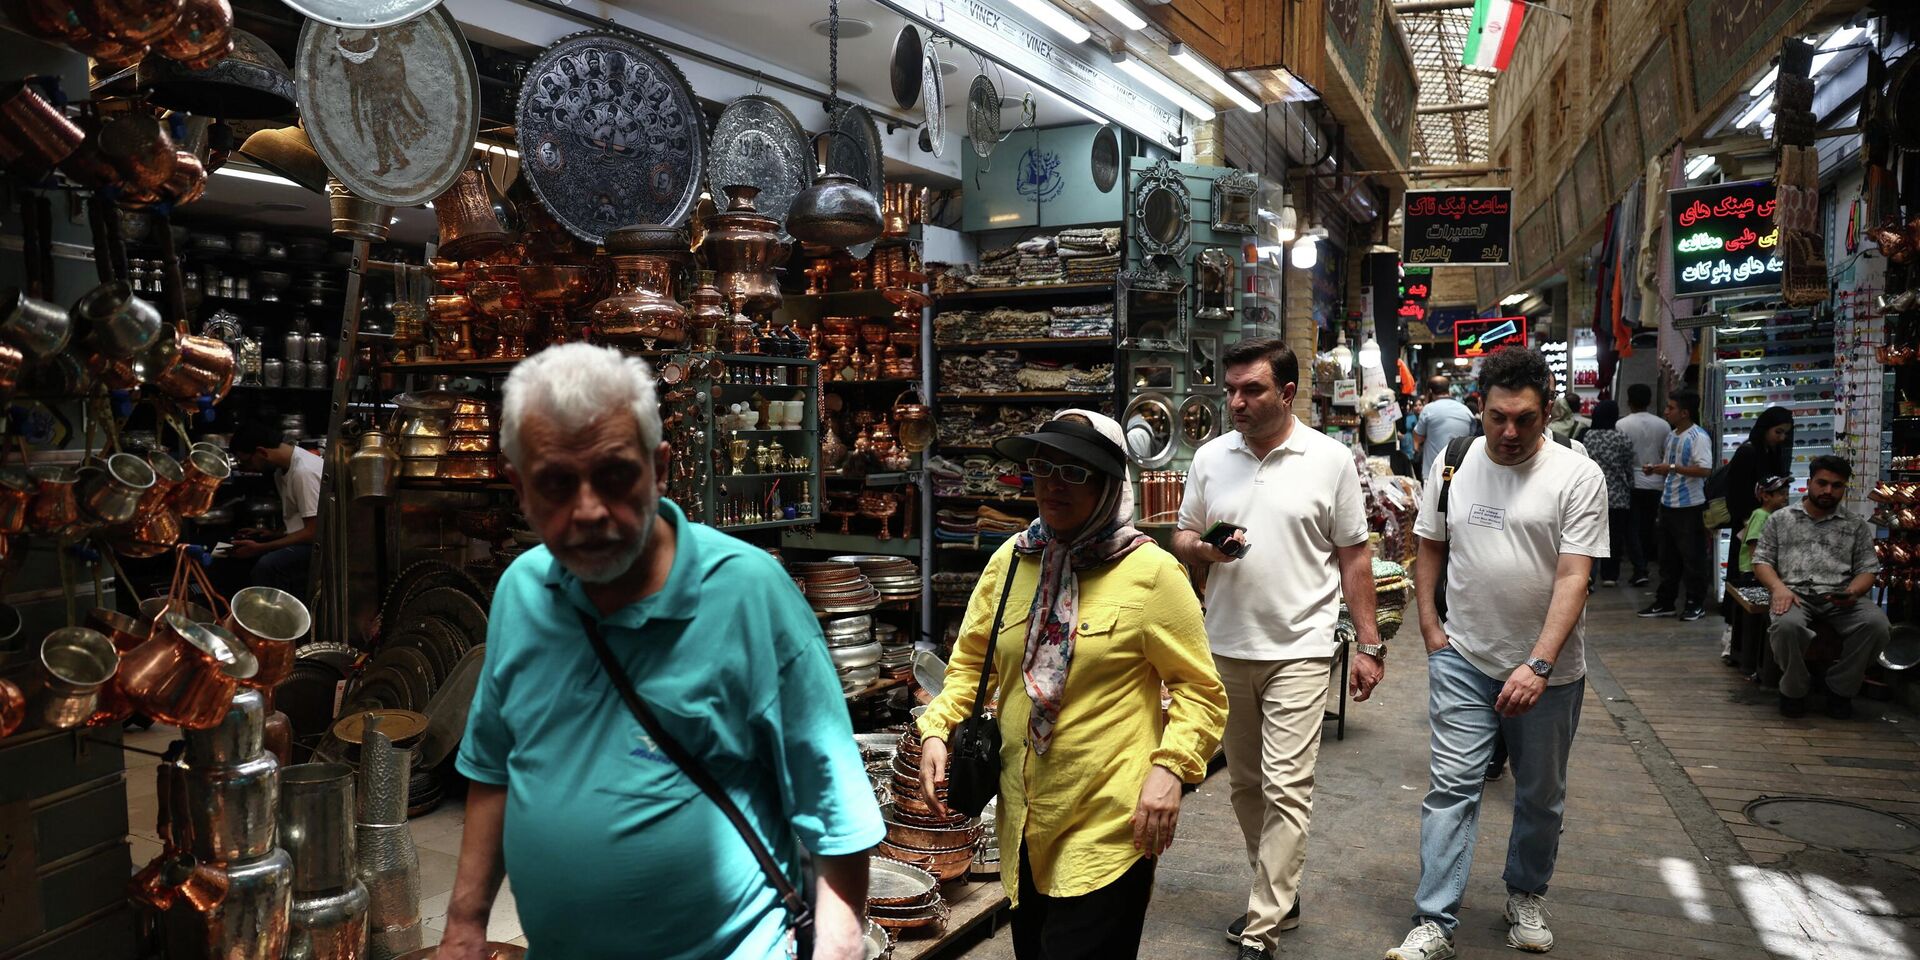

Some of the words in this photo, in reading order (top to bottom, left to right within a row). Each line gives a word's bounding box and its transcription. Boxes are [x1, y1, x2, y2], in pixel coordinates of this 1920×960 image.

[969, 1, 1001, 31] VINEX
[1026, 33, 1054, 60] VINEX
[1408, 196, 1437, 216] تاک
[1438, 195, 1466, 220] تیک
[1468, 195, 1508, 215] ساعت
[1679, 200, 1711, 226] های
[1713, 196, 1755, 219] عینک
[1426, 223, 1488, 243] تعمیرات
[1678, 232, 1723, 253] مطالعه
[1725, 228, 1757, 251] طبی
[1409, 245, 1452, 263] باطری
[1481, 244, 1503, 262] بند
[1733, 255, 1765, 281] های
